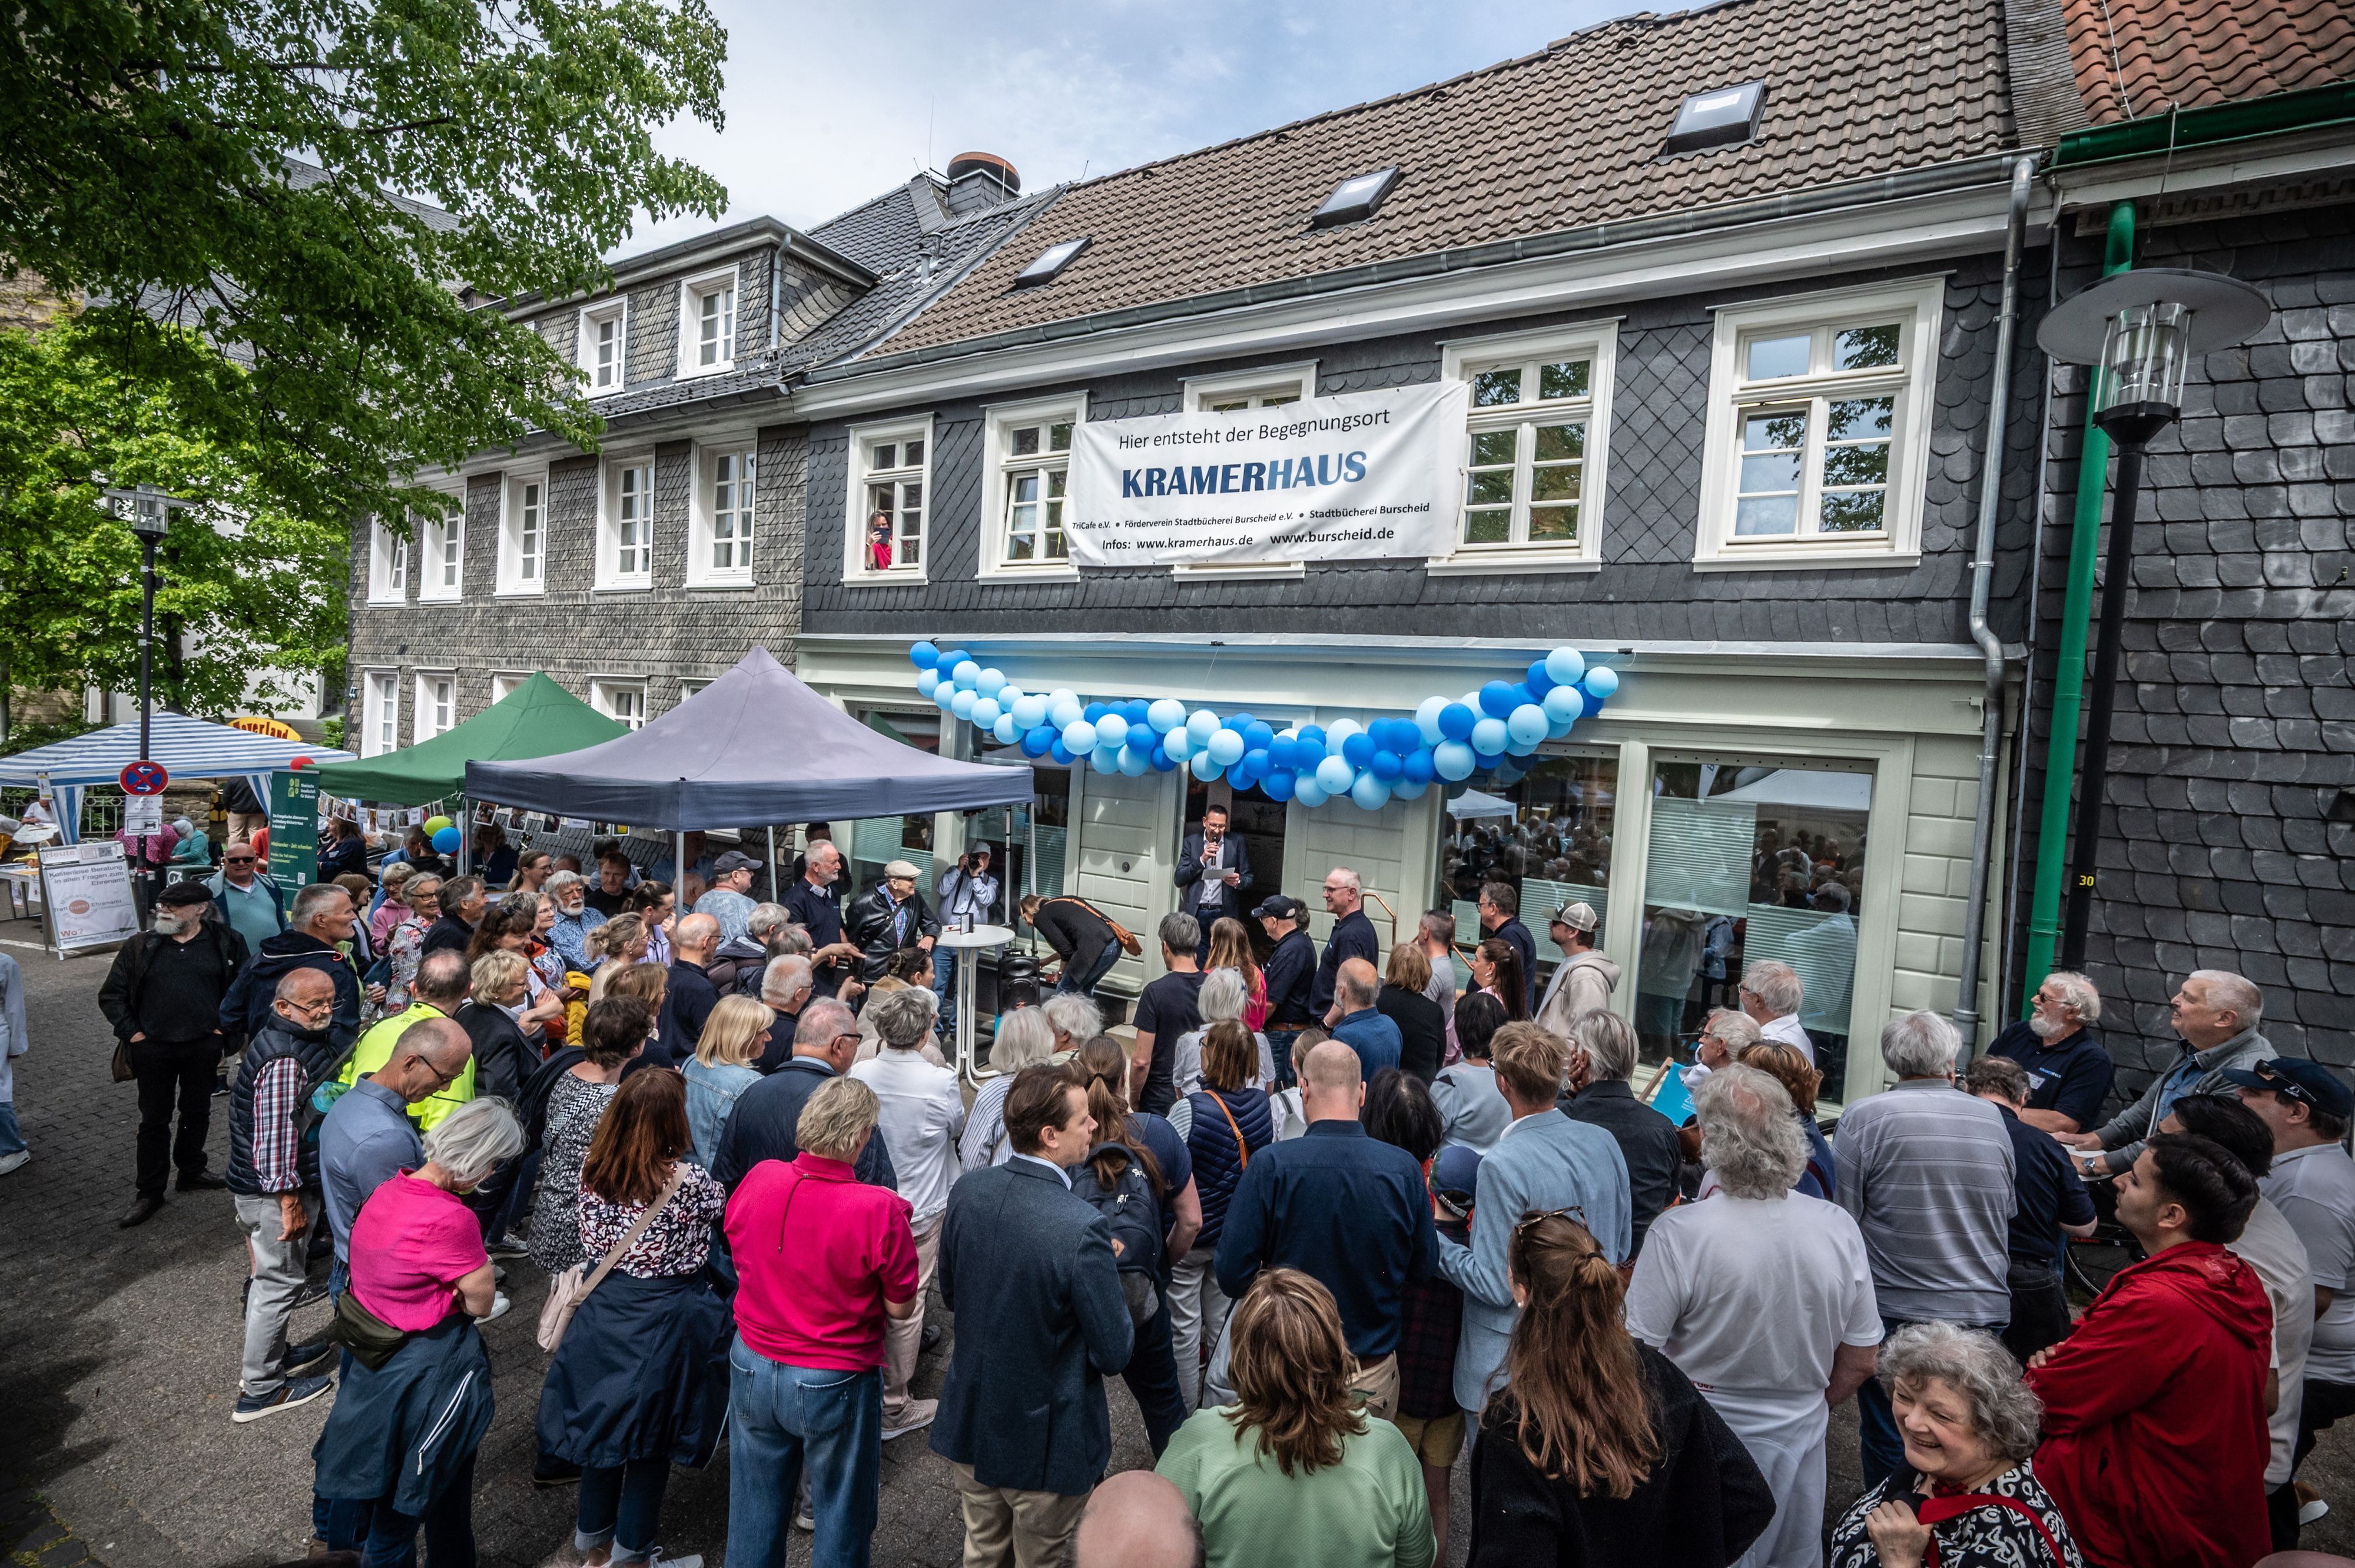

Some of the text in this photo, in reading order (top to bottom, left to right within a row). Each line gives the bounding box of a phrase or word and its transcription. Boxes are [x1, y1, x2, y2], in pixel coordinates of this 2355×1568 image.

[1119, 409, 1390, 449] Hier entsteht der Begegnungsort
[1122, 451, 1367, 498] KRAMERHAUS
[1125, 519, 1173, 528] Förderverein
[1175, 516, 1233, 526] Stadtbücherei
[1235, 513, 1276, 523] Burscheid
[1279, 513, 1293, 521] e.V.
[1309, 506, 1377, 518] Stadtbücherei
[1379, 503, 1429, 514] Burscheid
[1102, 527, 1394, 549] Infos: www.kramerhaus.de www.burscheid.de
[45, 849, 75, 859] Heute
[49, 865, 122, 878] Kostenlose Beratung
[91, 878, 125, 886] Ehrenamt
[2079, 875, 2094, 886] 30
[91, 899, 122, 907] Ehrenamt
[61, 928, 84, 937] Wo?
